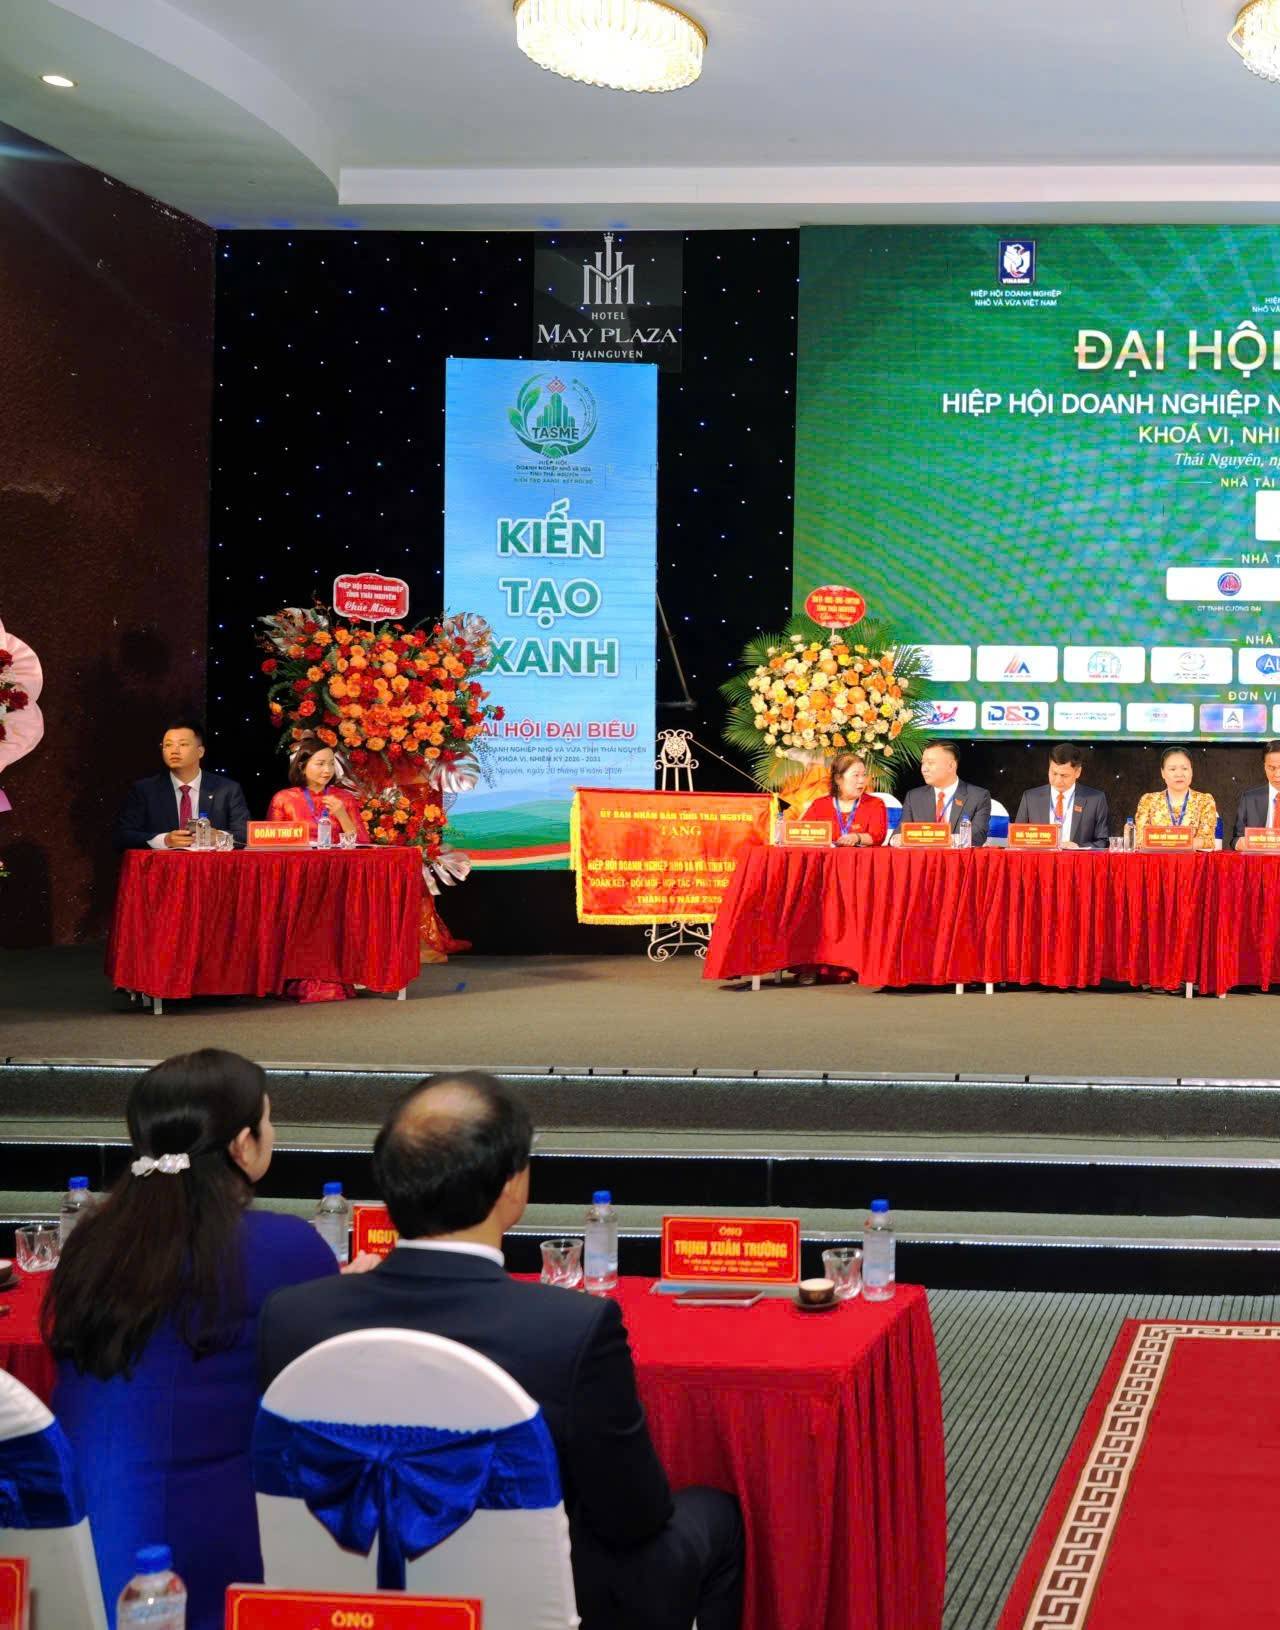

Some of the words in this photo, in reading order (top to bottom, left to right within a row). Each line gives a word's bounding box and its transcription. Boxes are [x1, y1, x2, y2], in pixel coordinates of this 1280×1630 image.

[592, 312, 625, 320] HOTEL
[537, 324, 594, 344] MAY
[600, 328, 678, 343] PLAZA
[571, 350, 643, 358] THAINGUYEN
[1074, 329, 1165, 378] ĐẠI
[943, 389, 1002, 416] HIỆP
[1009, 389, 1053, 416] HỘI
[1062, 394, 1154, 414] DOANH
[1162, 390, 1260, 416] NGHIỆP
[532, 427, 580, 440] TASME
[1138, 423, 1200, 444] KHOÁ
[1208, 427, 1234, 446] VI,
[1174, 452, 1204, 466] Thái
[1208, 453, 1264, 470] Nguyên,
[1220, 477, 1249, 488] NHÀ
[1254, 477, 1276, 488] TÀI
[500, 502, 604, 554] KIẾN
[1241, 554, 1270, 565] NHÀ
[502, 581, 599, 626] TẠO
[1246, 635, 1273, 647] NHÀ
[488, 640, 616, 673] XANH
[1228, 692, 1258, 704] ĐƠN
[1264, 692, 1276, 704] VỊ
[480, 722, 498, 740] ẠI
[506, 720, 540, 740] HỘI
[546, 723, 581, 742] ĐẠI
[588, 719, 635, 738] BIỂU
[675, 1240, 708, 1258] TRỊNH
[710, 1238, 740, 1256] XUÂN
[743, 1240, 788, 1258] TRƯỜNG
[332, 1610, 374, 1628] ÔNG
